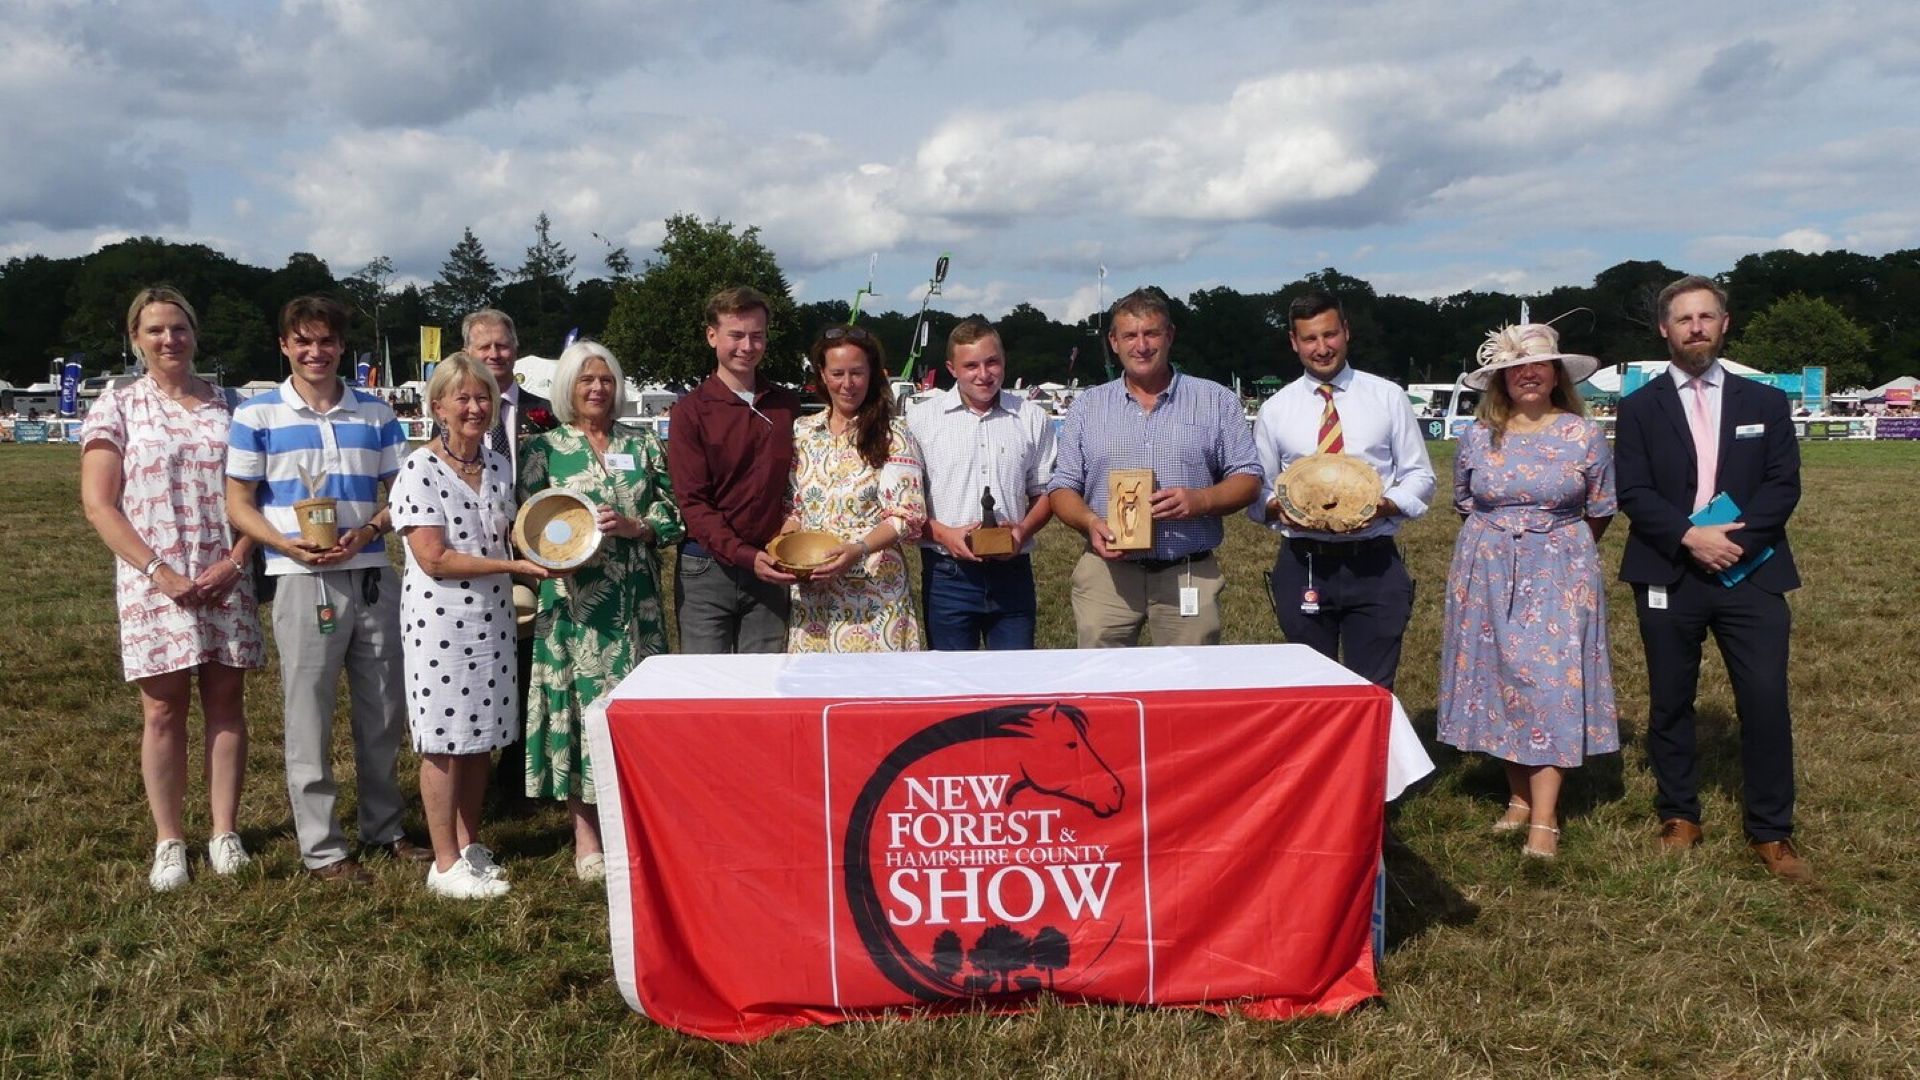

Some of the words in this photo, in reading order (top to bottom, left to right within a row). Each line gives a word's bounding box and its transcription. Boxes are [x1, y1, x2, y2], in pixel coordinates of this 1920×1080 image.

[903, 774, 1010, 810] NEW
[887, 808, 1061, 848] FOREST
[1059, 827, 1077, 843] &
[886, 848, 1009, 867] HAMPSHIRE
[1015, 845, 1110, 865] COUNTY
[888, 861, 1122, 926] SHOW
